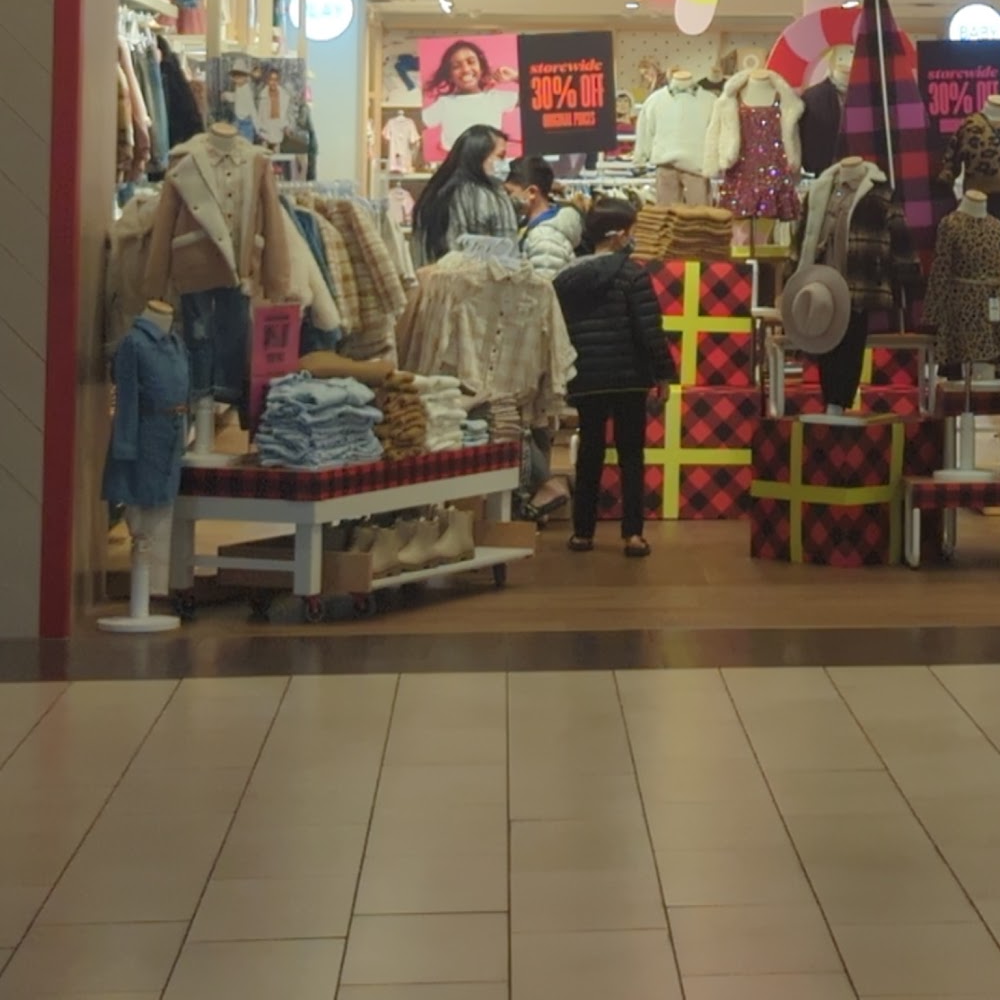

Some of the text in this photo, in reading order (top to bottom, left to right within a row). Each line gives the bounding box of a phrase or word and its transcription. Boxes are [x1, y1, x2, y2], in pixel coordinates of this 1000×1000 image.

[530, 59, 603, 73] storewide
[928, 66, 998, 79] storewide
[531, 73, 604, 110] 30% OFF
[928, 81, 973, 115] 30%
